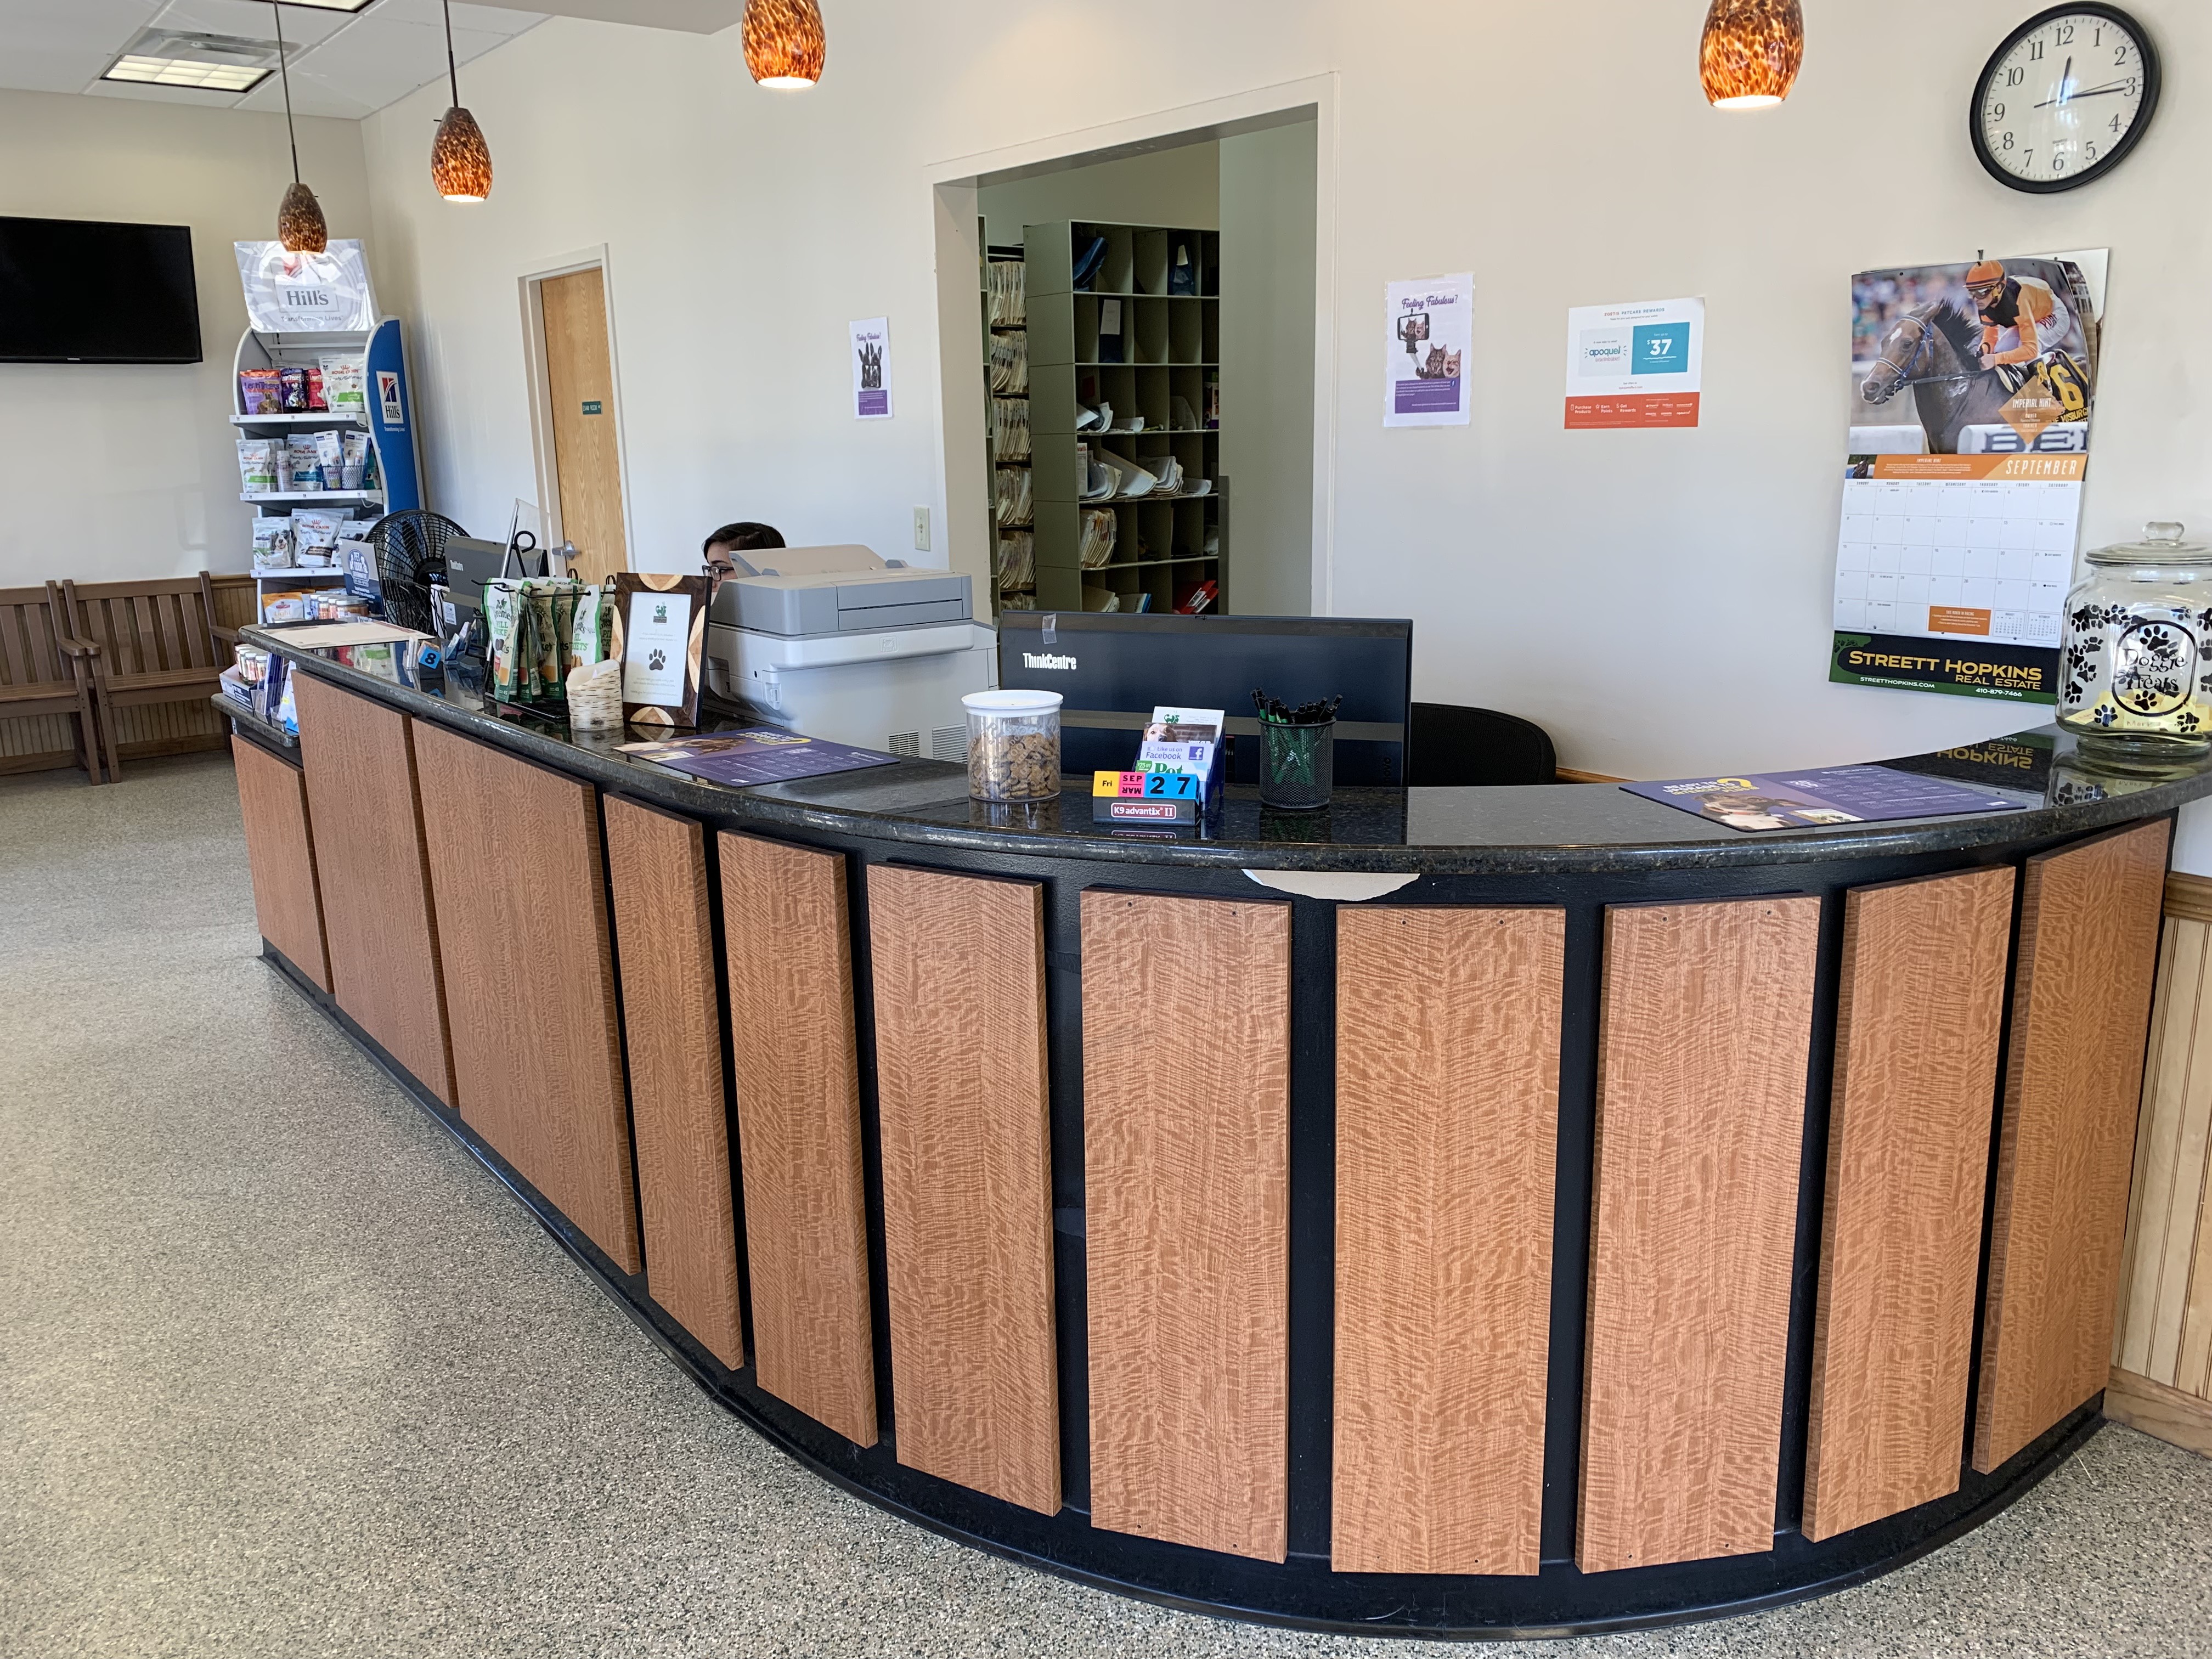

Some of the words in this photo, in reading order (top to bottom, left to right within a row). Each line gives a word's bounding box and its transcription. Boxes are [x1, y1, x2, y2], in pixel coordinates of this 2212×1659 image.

[2055, 25, 2074, 47] 12
[2094, 28, 2101, 47] 1
[2029, 41, 2044, 61] 11
[2114, 46, 2126, 65] 2
[2006, 66, 2024, 87] 10
[2124, 77, 2136, 97] 3
[1994, 103, 2005, 122] 9
[2108, 113, 2121, 132] 4
[2002, 132, 2013, 150] 8
[2085, 141, 2096, 160] 5
[2023, 149, 2033, 168] 7
[2053, 152, 2064, 171] 6
[286, 290, 329, 306] Hill's
[1401, 298, 1425, 311] Feeling
[2013, 398, 2038, 408] IMPERIAL
[2039, 398, 2052, 407] HINT
[2006, 460, 2077, 475] SEPTEMBER
[424, 652, 437, 665] 8
[1022, 652, 1077, 670] ThinkCentre
[1849, 650, 1940, 671] STREETT
[1944, 659, 2042, 681] HOPKINS
[2121, 648, 2188, 673] Doggie
[1860, 676, 1935, 689] STREETTHOPKINS.COM
[1955, 674, 1990, 686] REAL
[1994, 678, 2041, 690] ESTATE
[1976, 687, 2023, 697] 410-879-7466
[1146, 752, 1182, 760] Facebook
[1150, 776, 1165, 794] 2
[1177, 777, 1191, 795] 7
[1164, 808, 1173, 817] II
